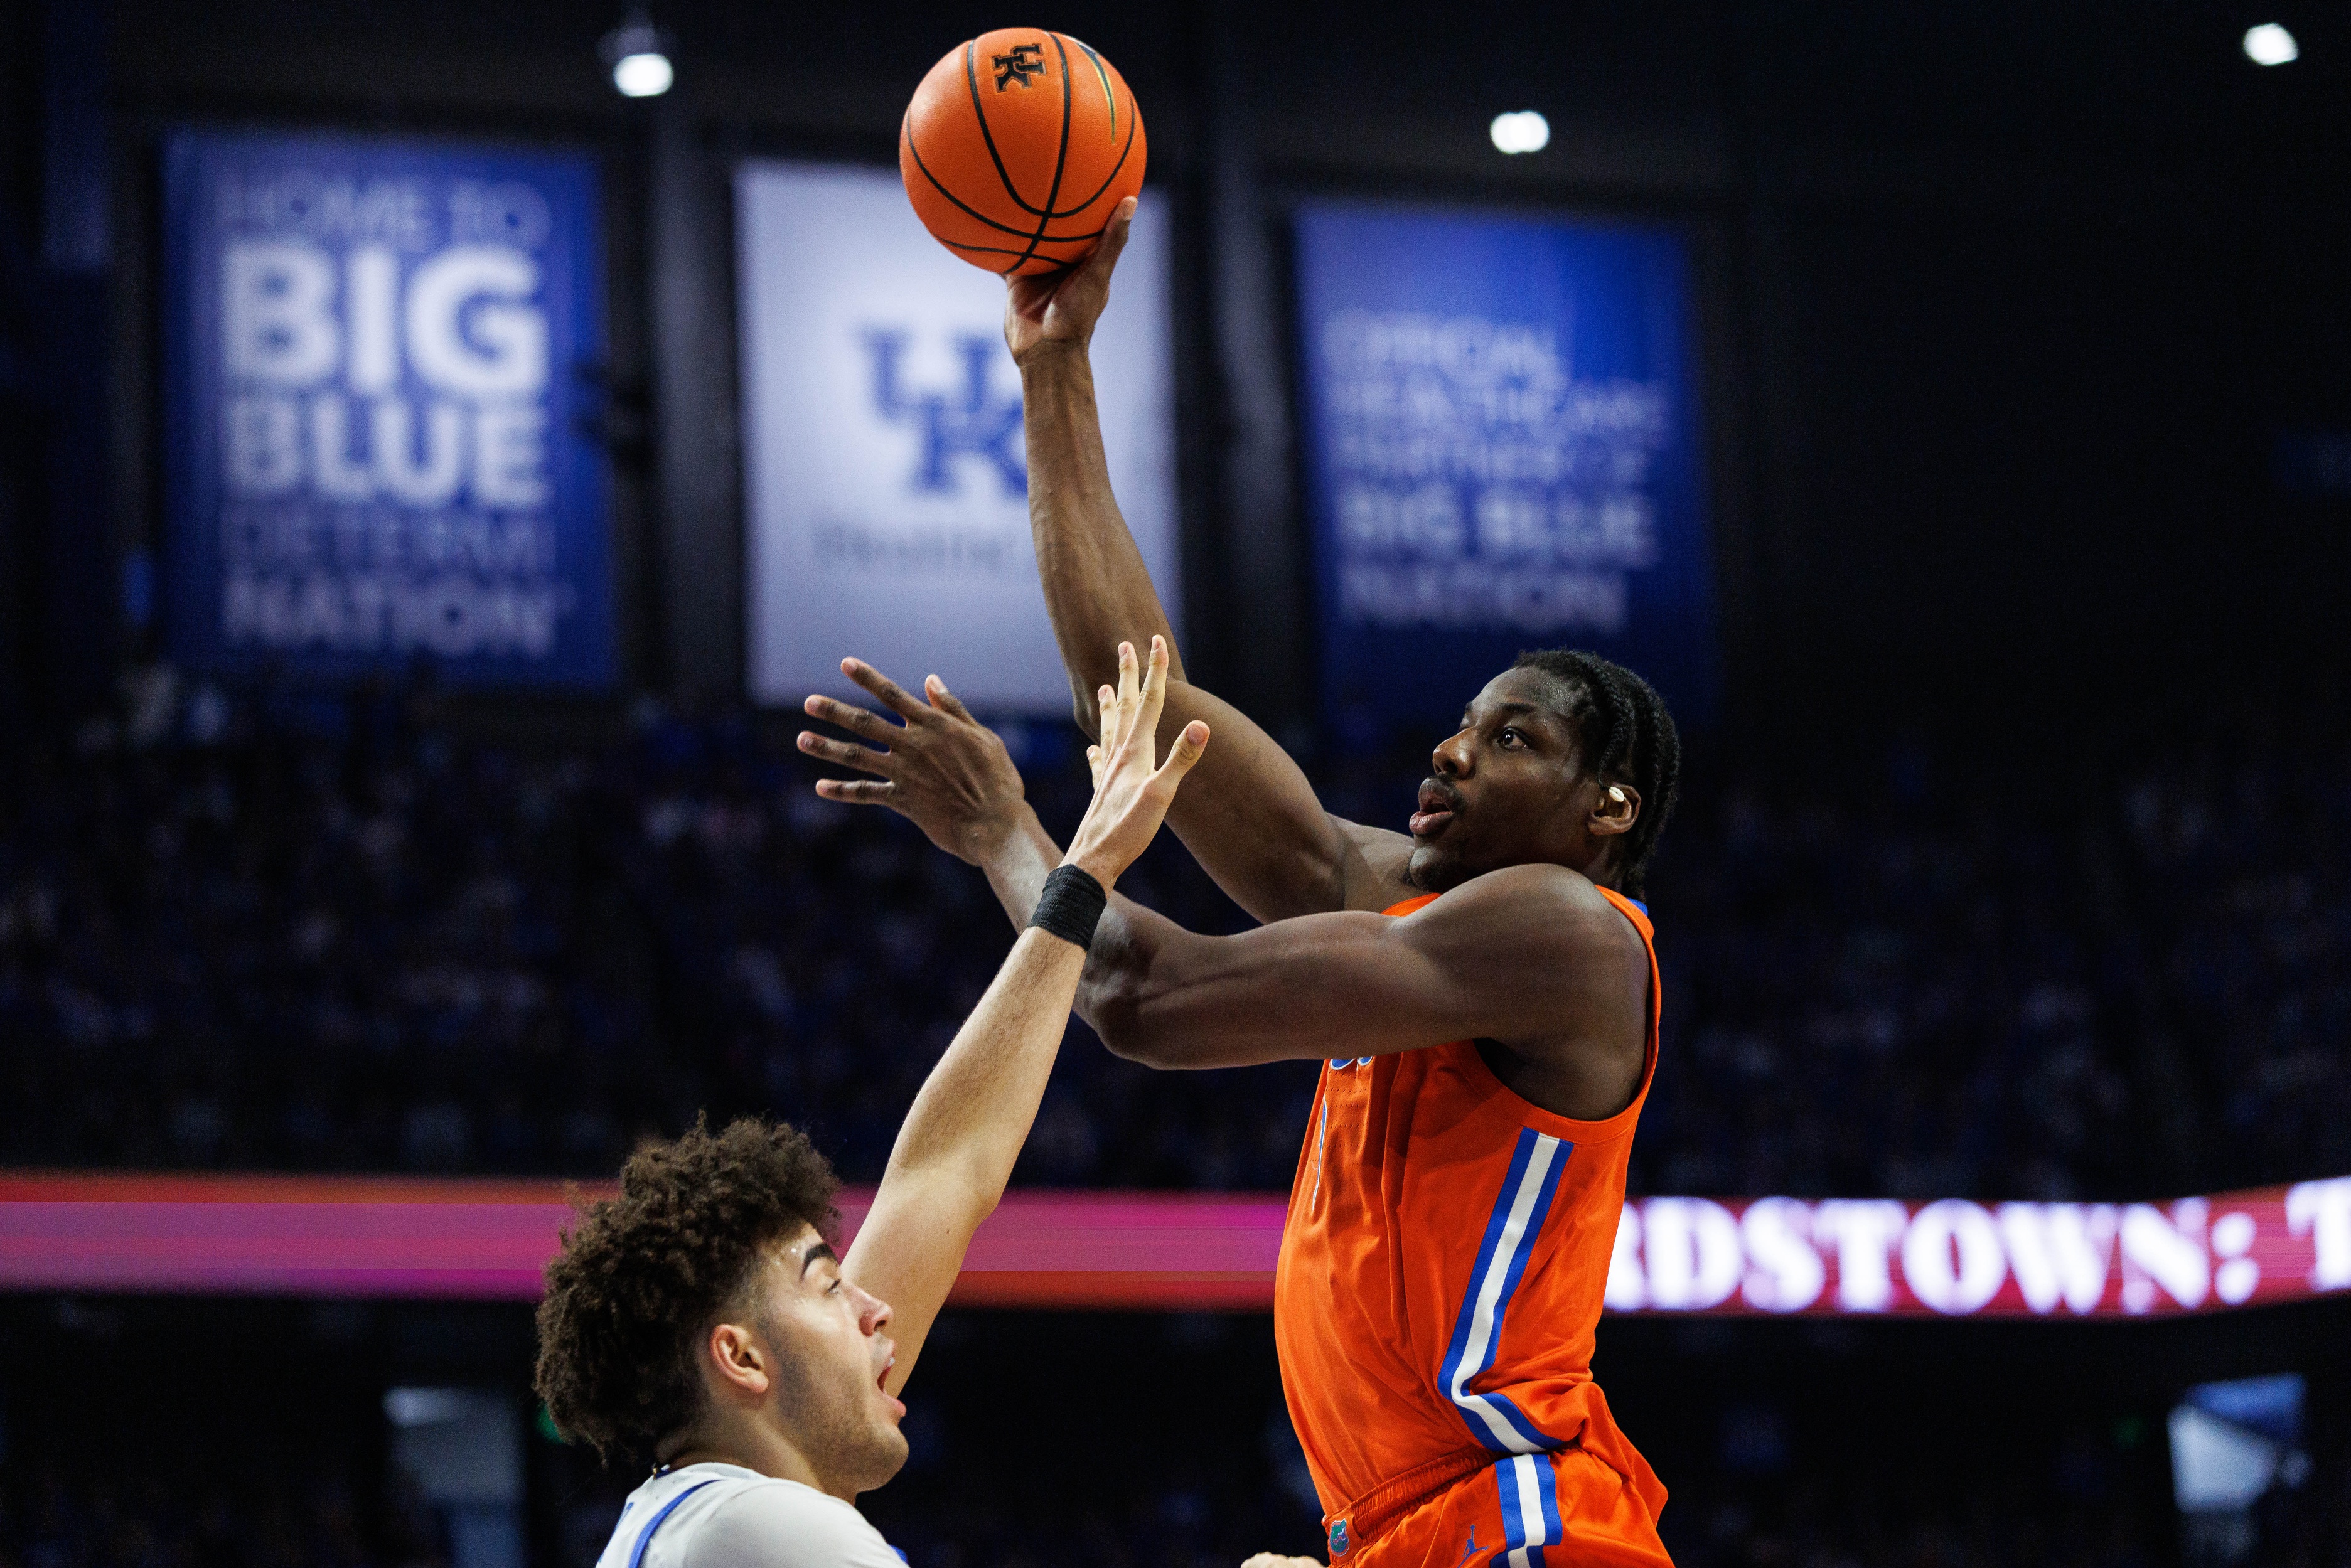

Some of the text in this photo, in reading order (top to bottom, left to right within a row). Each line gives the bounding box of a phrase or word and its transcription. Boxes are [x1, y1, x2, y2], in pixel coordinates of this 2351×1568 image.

[219, 169, 549, 252] HOME TO
[221, 240, 546, 402] BIG
[222, 394, 550, 509] BLUE
[856, 323, 1029, 497] UK
[1338, 486, 1657, 567] BIG BLUE
[222, 572, 556, 656] NATION
[1339, 565, 1627, 634] NATION
